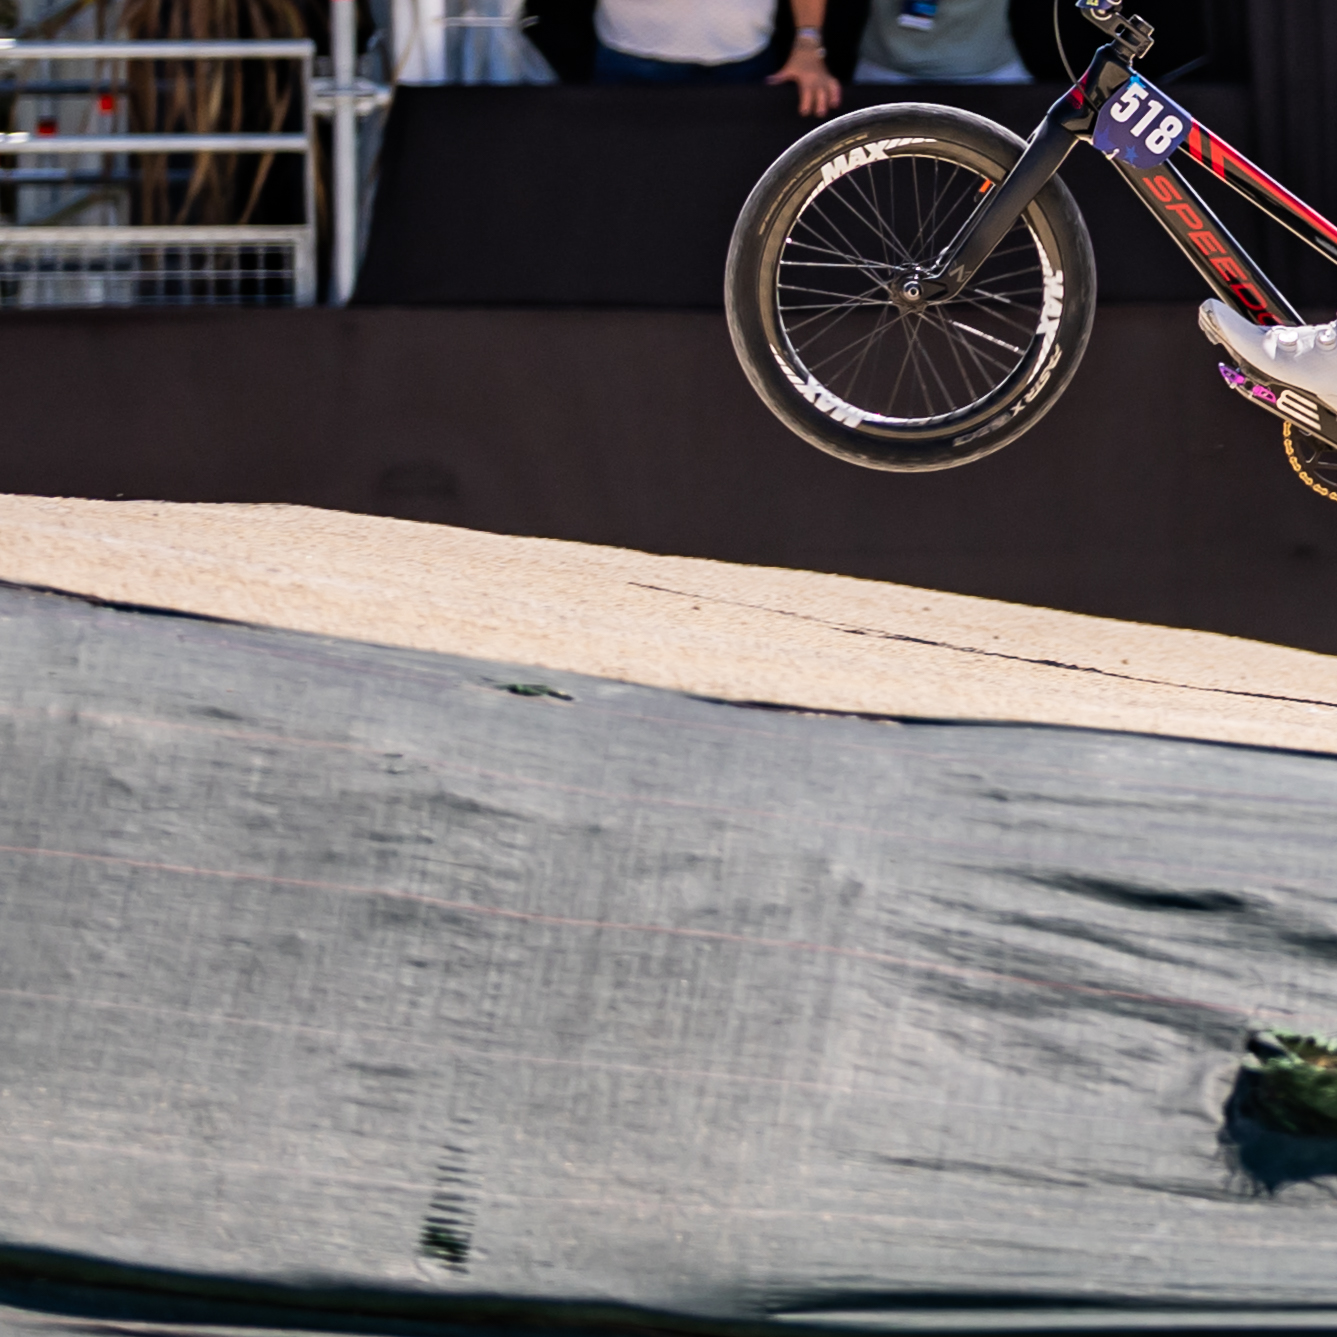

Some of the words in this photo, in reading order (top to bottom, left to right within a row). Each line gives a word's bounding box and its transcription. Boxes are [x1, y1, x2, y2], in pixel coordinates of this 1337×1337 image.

[1110, 82, 1183, 154] 518
[820, 139, 890, 186] MAX
[1024, 343, 1063, 403] FASTR
